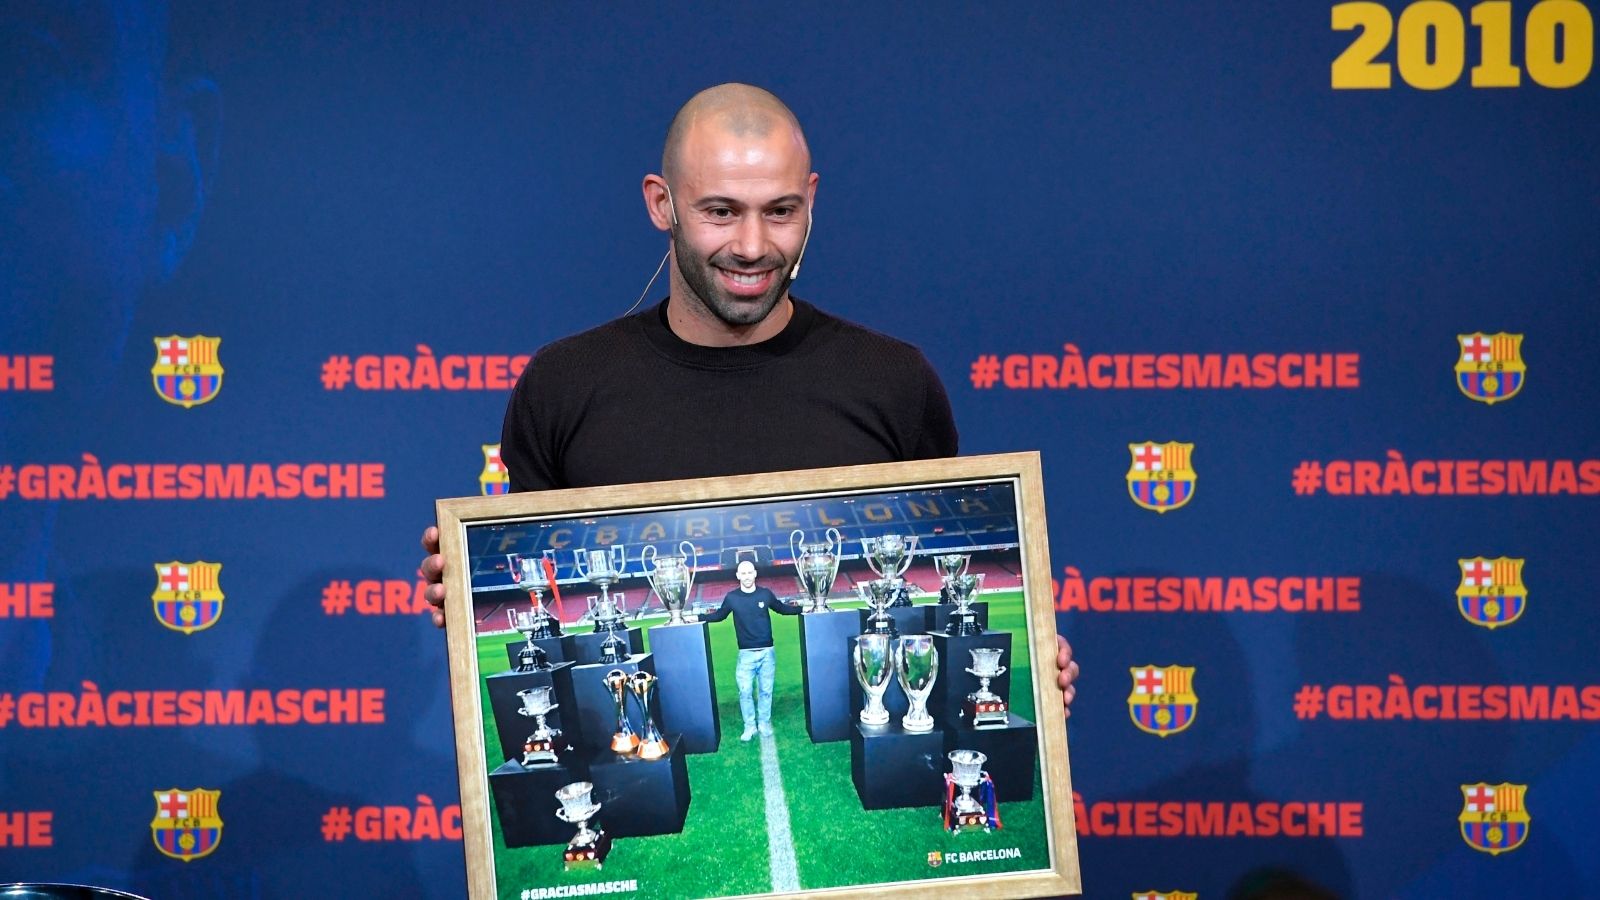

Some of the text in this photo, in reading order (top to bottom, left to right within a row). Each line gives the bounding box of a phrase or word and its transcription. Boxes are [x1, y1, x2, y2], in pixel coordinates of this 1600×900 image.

[1331, 0, 1594, 90] 2010
[971, 344, 1361, 390] #GRÀCIESMASCHE
[945, 848, 1022, 864] FC BARCELONA
[520, 880, 639, 900] #GRACIASMASCHE
